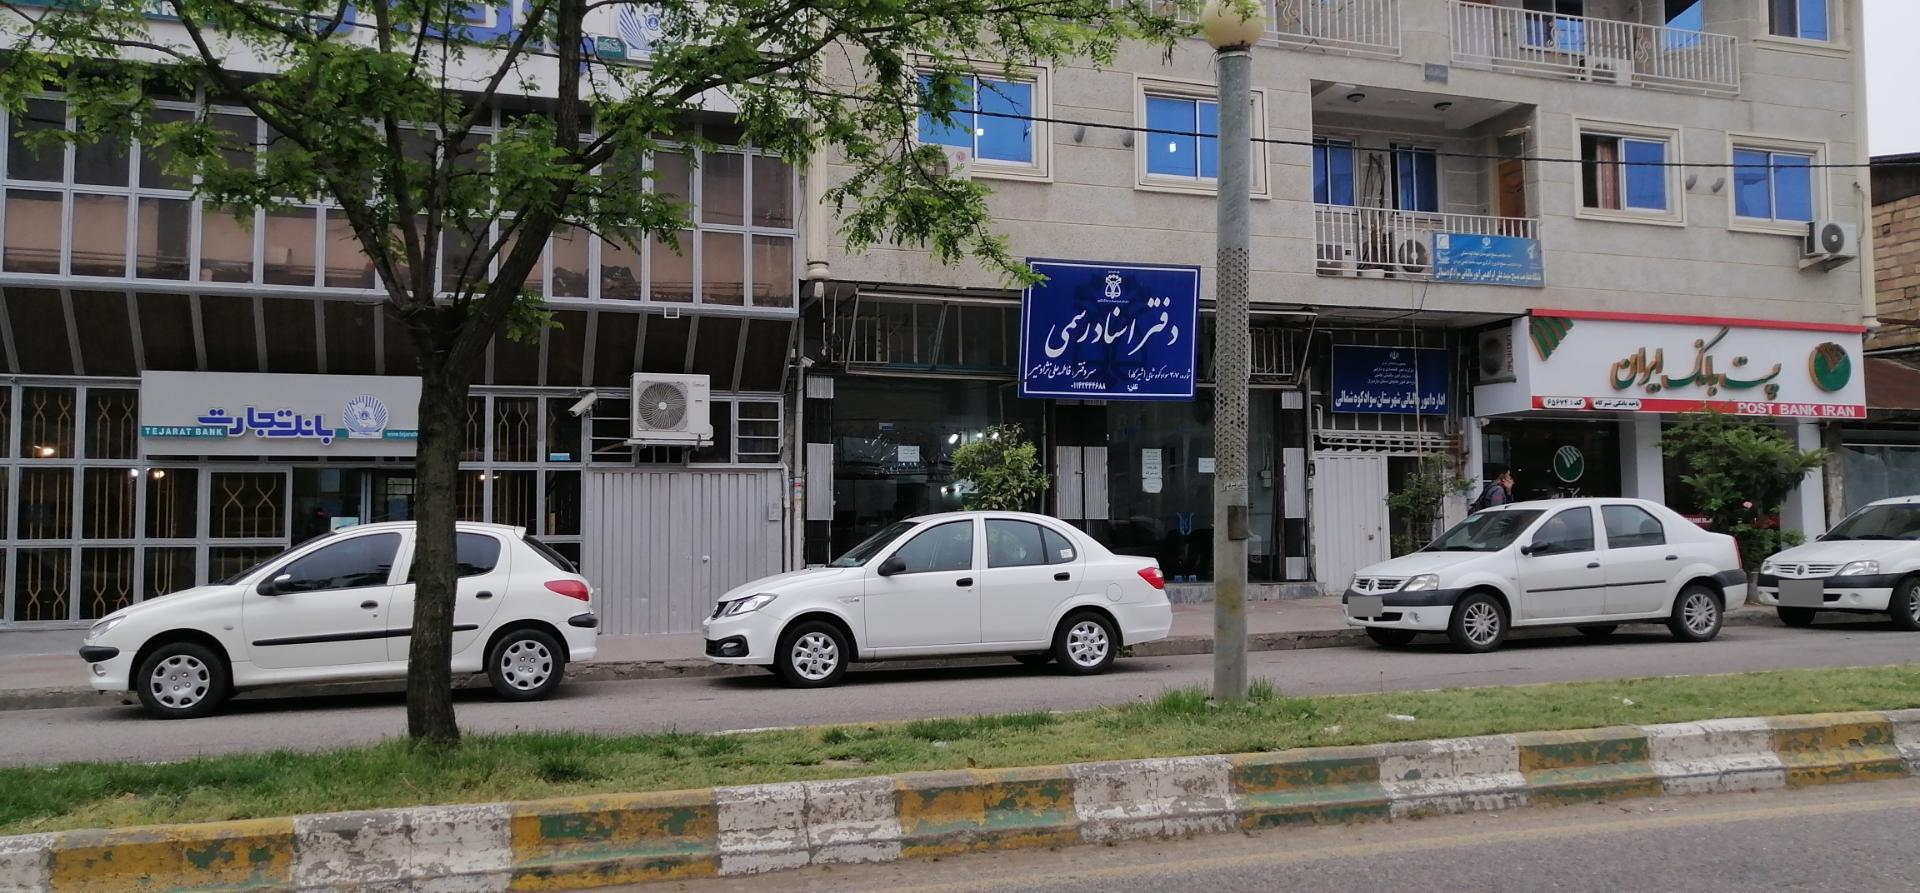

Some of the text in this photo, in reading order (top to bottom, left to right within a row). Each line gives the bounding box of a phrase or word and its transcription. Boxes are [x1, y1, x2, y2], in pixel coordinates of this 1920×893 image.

[1045, 296, 1179, 358] دفتر اسناد رسمی
[1610, 327, 1782, 400] پست بانک ایران
[197, 406, 334, 446] بانک تجارت
[1737, 402, 1856, 417] POST BANK IRAN
[144, 426, 224, 437] TEJARAT BANK
